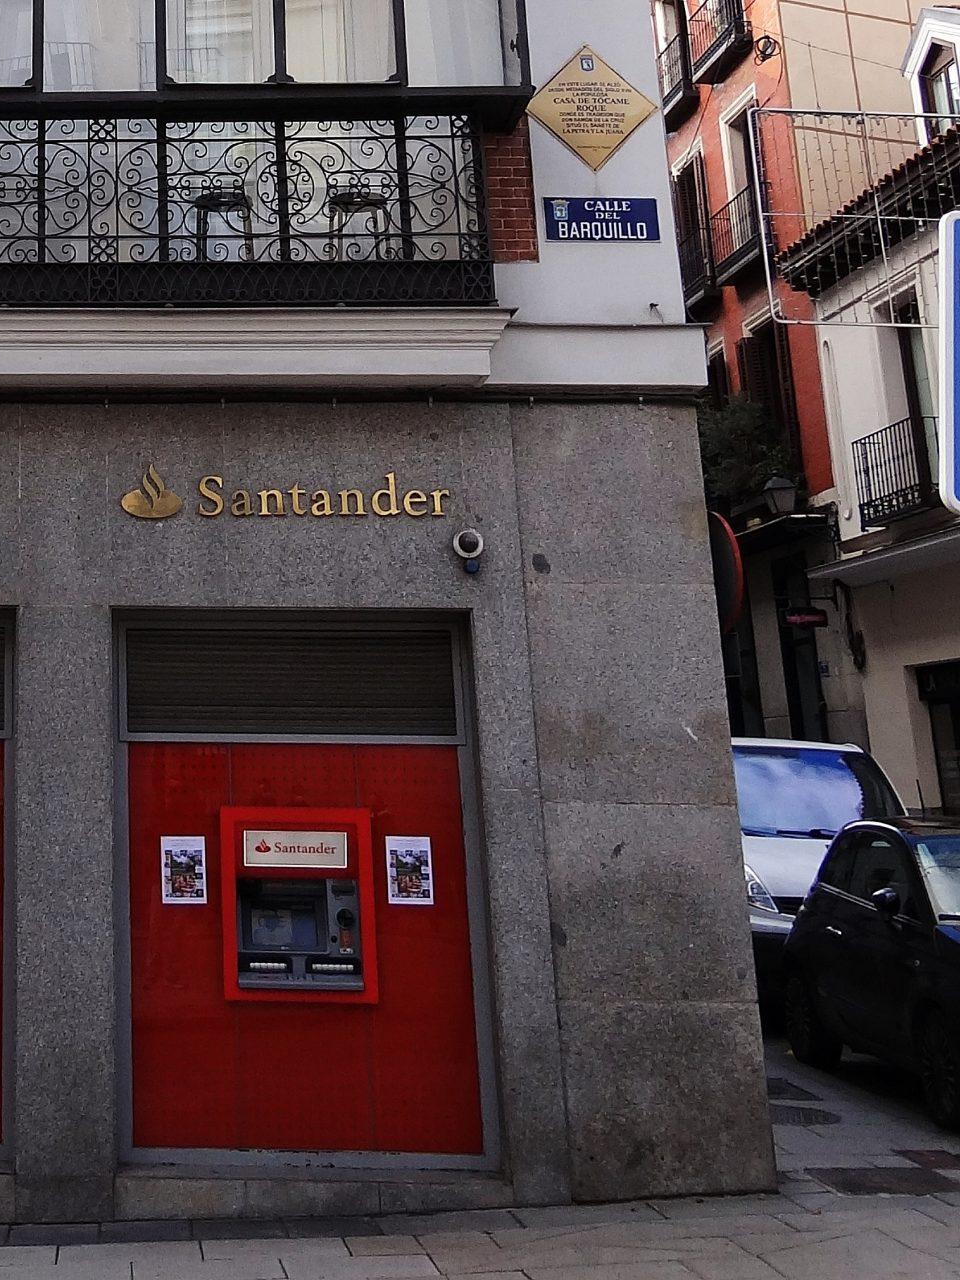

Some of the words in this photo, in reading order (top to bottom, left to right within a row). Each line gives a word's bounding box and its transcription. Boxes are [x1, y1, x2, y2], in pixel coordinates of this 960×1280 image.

[584, 200, 631, 212] CALLE
[558, 222, 647, 240] BARQUILLO
[198, 472, 450, 517] Santander
[274, 842, 337, 856] Santander
